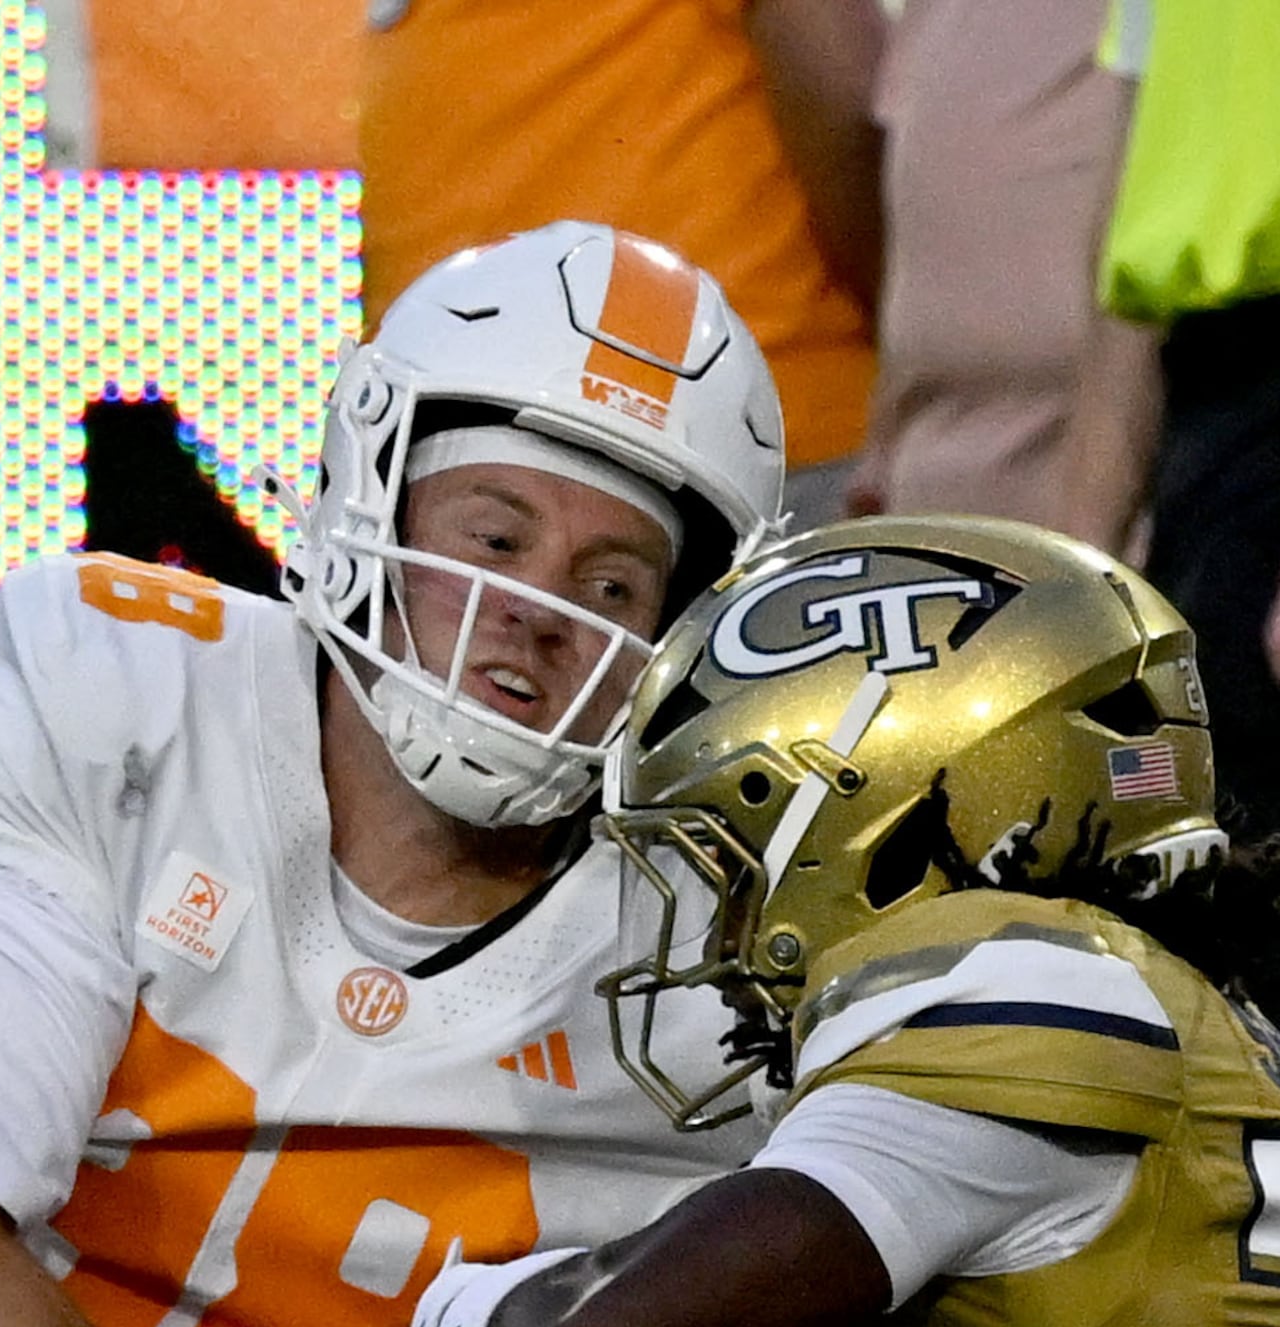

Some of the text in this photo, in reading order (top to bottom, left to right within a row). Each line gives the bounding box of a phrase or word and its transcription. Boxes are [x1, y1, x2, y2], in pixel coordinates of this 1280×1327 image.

[708, 549, 993, 680] GT
[145, 914, 217, 960] HORIZON
[166, 907, 211, 937] FIRST
[342, 973, 402, 1029] SEC
